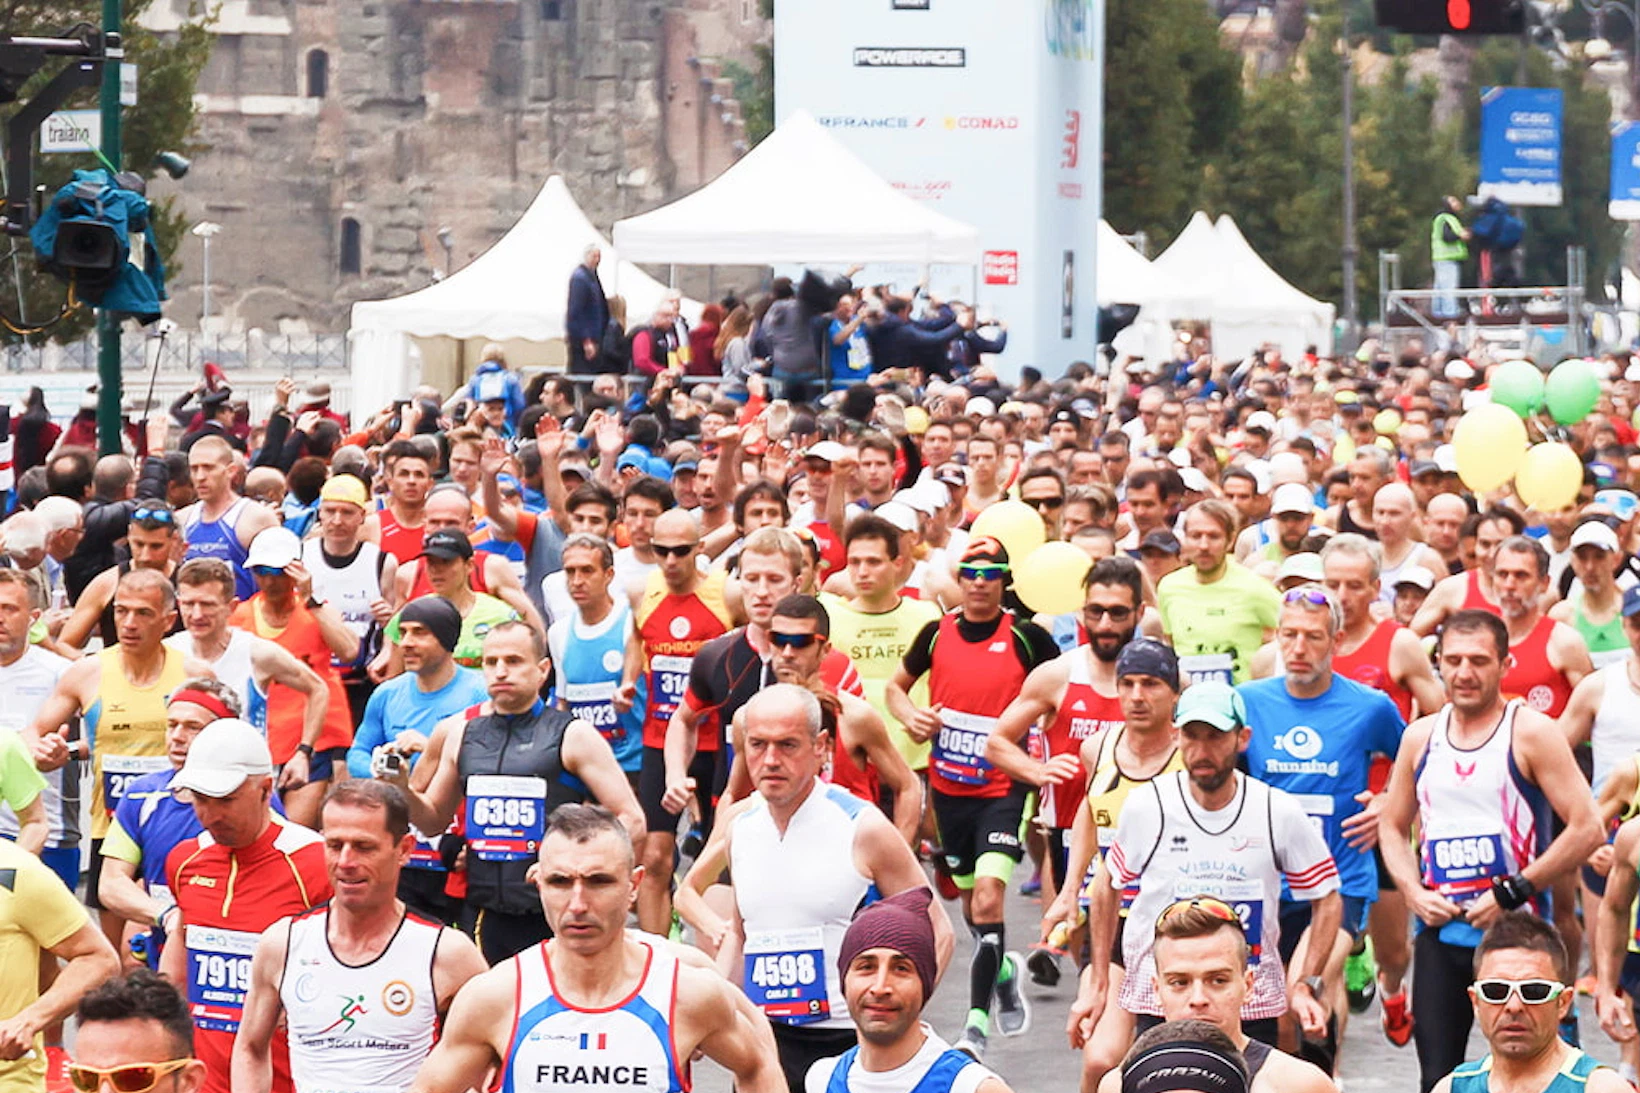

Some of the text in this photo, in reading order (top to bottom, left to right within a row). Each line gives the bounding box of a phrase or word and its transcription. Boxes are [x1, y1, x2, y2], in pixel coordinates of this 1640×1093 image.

[855, 48, 963, 66] POWERADE
[818, 117, 908, 129] RFRANCE
[958, 116, 1018, 129] CONAD
[49, 125, 89, 143] traiano
[851, 644, 906, 660] STAFF
[938, 728, 987, 757] 8056
[1265, 759, 1339, 777] Running
[473, 798, 537, 828] 6385
[1434, 837, 1496, 869] 6650
[1178, 861, 1248, 878] VISUAL
[195, 954, 252, 991] 7919
[752, 953, 816, 987] 4598
[327, 1037, 363, 1050] Sport
[536, 1065, 649, 1086] FRANCE
